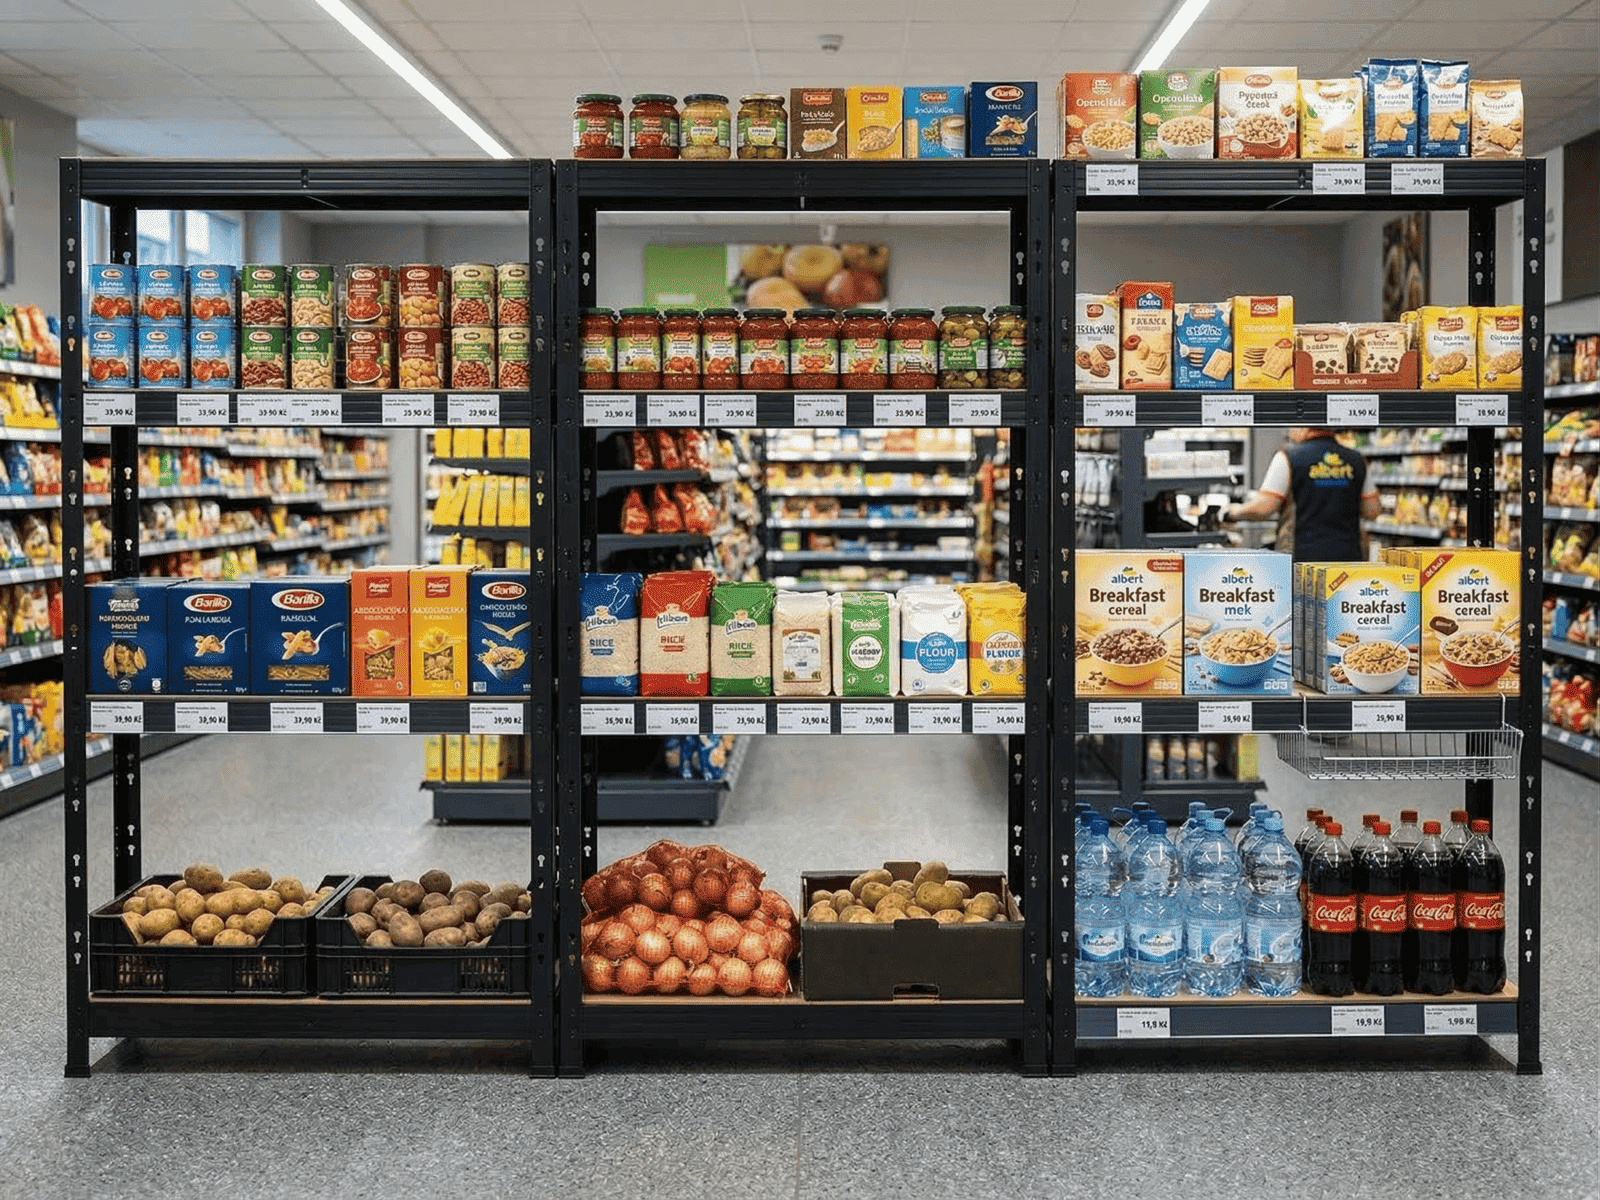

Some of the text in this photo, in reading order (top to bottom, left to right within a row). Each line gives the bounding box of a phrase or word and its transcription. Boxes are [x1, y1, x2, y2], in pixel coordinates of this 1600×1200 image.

[1111, 574, 1144, 584] albert
[1221, 574, 1254, 584] albert
[1457, 575, 1490, 586] albert
[1089, 587, 1166, 603] Breakfast
[1199, 587, 1275, 603] Breakfast
[1359, 586, 1389, 597] albert
[1438, 588, 1509, 604] Breakfast
[1108, 604, 1147, 616] cereal
[1224, 604, 1252, 616] mek
[1340, 600, 1407, 615] Breakfast
[1455, 604, 1492, 616] cereal
[1357, 614, 1391, 625] cereal
[918, 647, 956, 658] FLOUR
